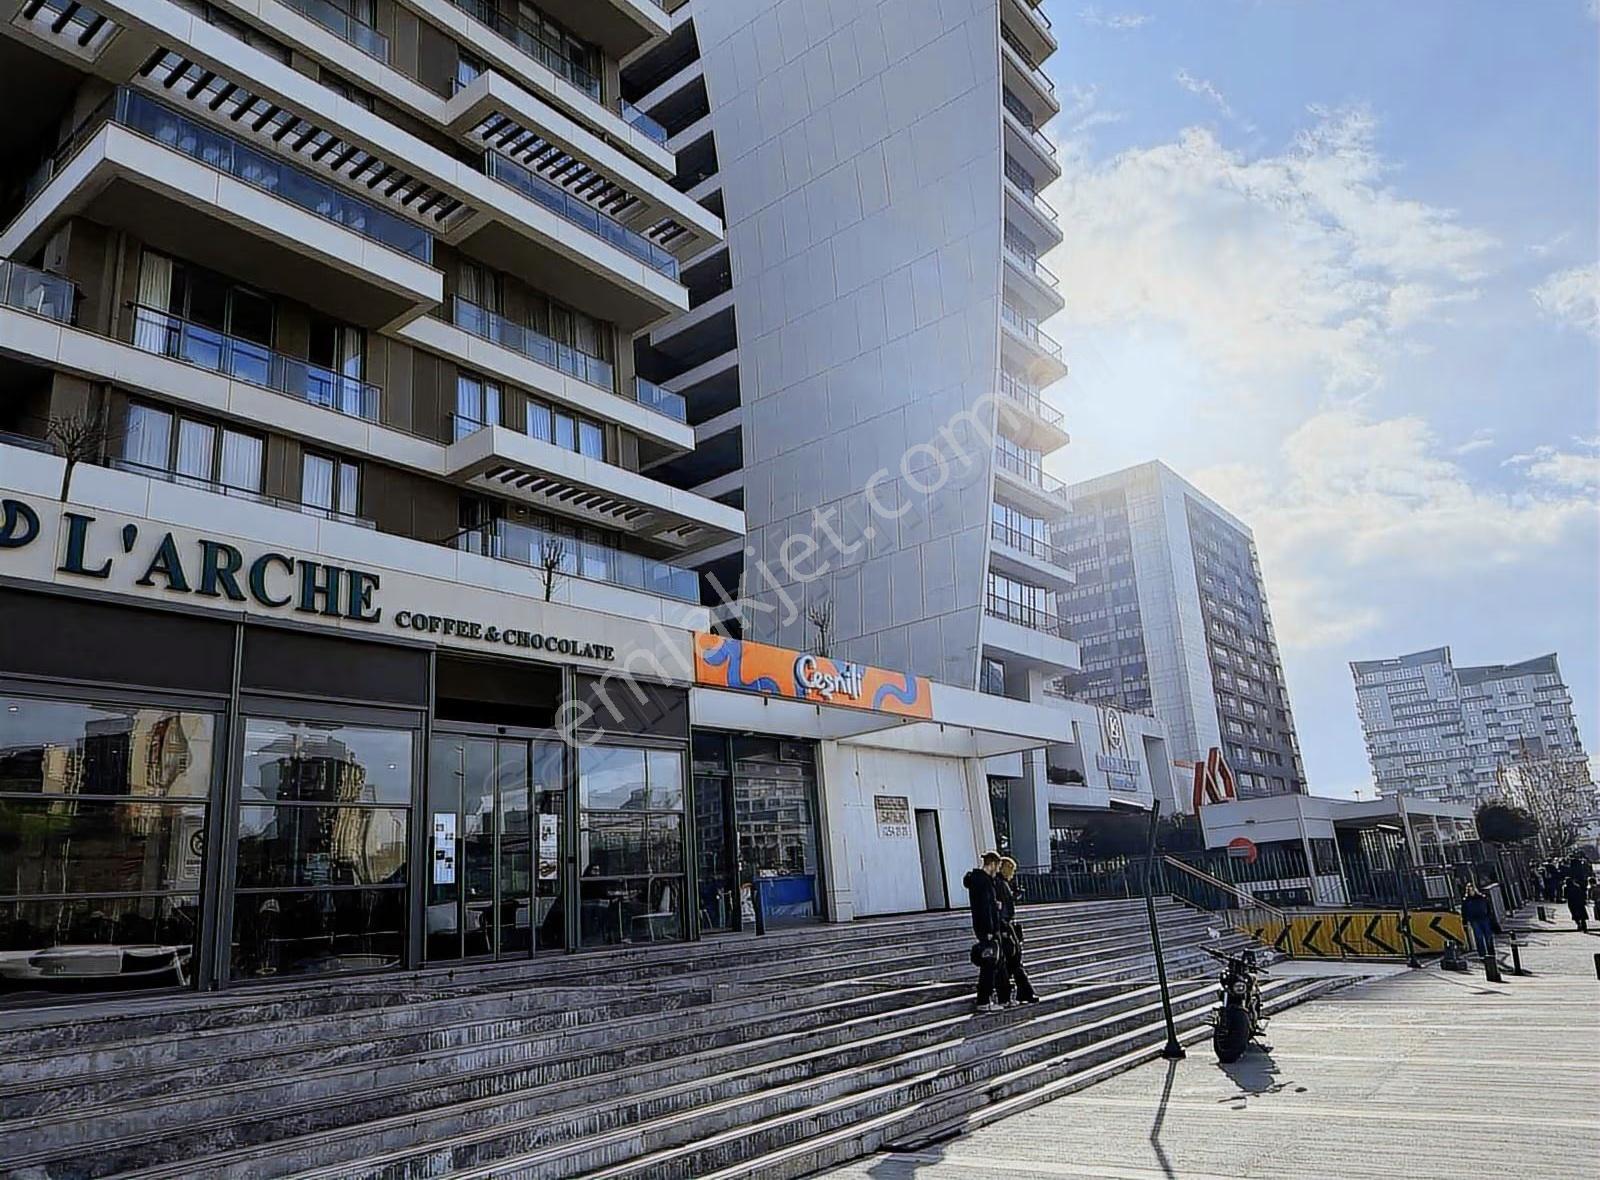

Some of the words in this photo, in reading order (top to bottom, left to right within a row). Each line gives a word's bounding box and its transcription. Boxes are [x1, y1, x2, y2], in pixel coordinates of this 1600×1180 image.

[57, 511, 381, 624] L'ARCHE
[394, 610, 482, 639] COFFEE
[484, 626, 500, 642] &
[502, 629, 615, 661] CHOCOLATE
